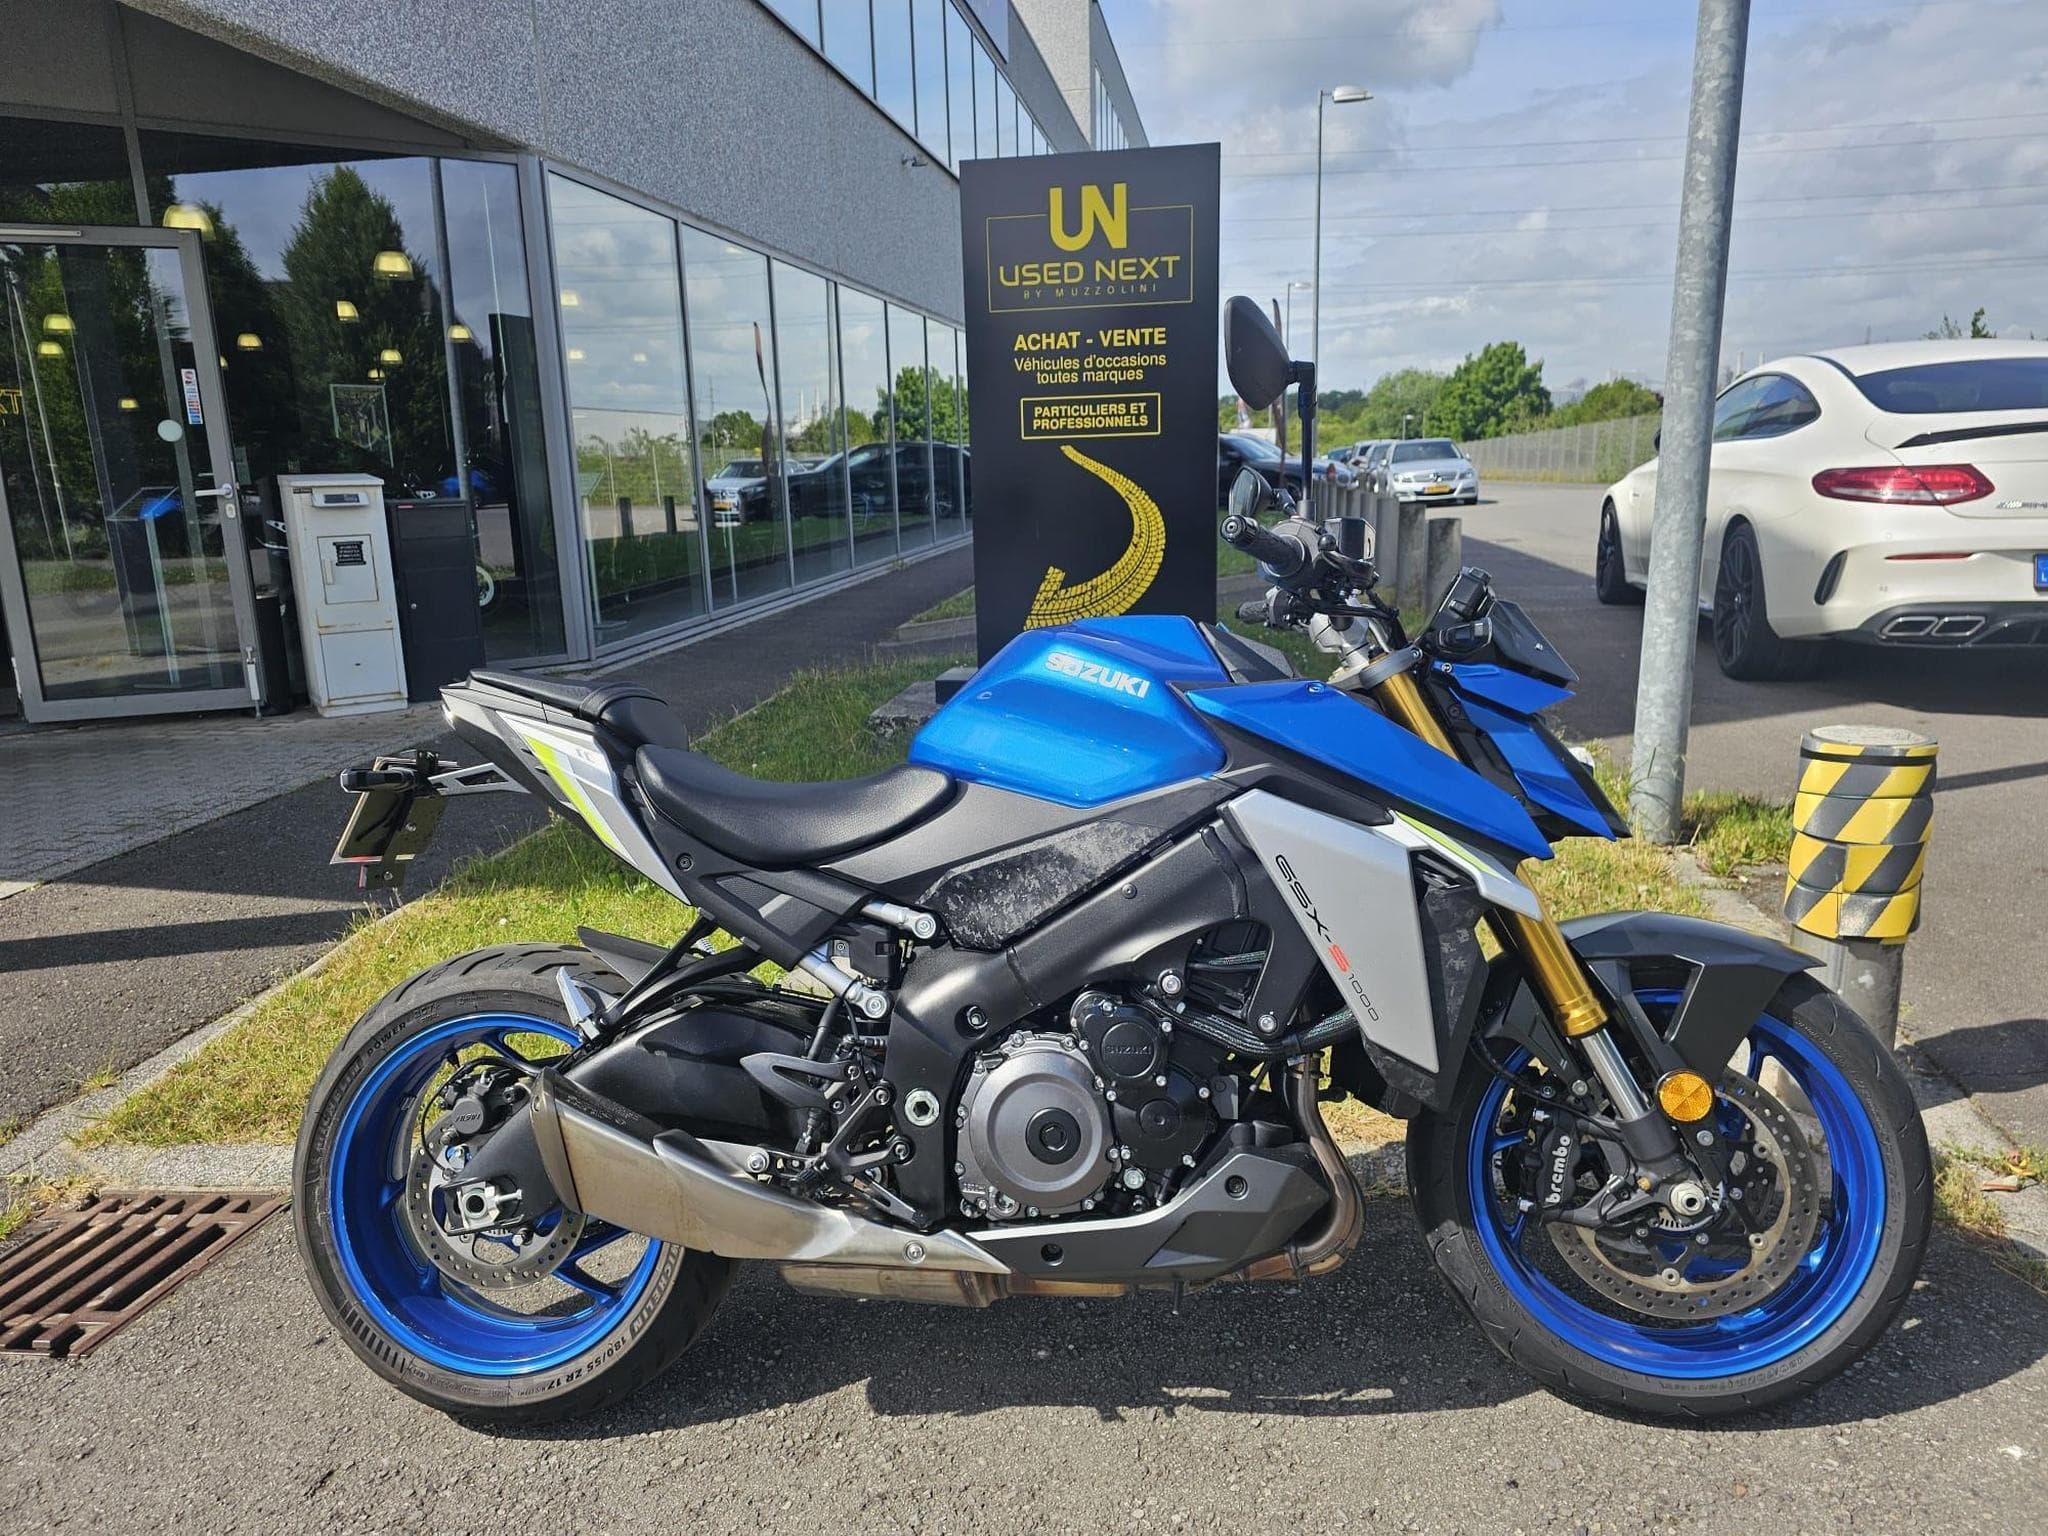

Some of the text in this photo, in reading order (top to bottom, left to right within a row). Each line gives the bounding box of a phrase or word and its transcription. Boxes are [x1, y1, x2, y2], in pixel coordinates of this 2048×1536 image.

[1049, 182, 1128, 252] UN
[999, 255, 1181, 287] USED NEXT
[1023, 283, 1157, 299] BY MUZZOLINI
[1014, 331, 1081, 351] ACHAT
[1099, 327, 1167, 348] VENTE
[1014, 352, 1167, 372] Véhicules d'occasions
[1037, 367, 1144, 384] toutes marques
[1033, 415, 1149, 430] PROFESSIONNELS
[1034, 402, 1147, 418] PARTICULIERS ET
[1044, 652, 1150, 699] SUZUKI
[1347, 973, 1379, 1021] 1000
[367, 1022, 406, 1057] POWER
[1104, 1044, 1152, 1055] SUZUKI
[1545, 1135, 1571, 1203] brembo
[587, 1336, 626, 1374] 180/55
